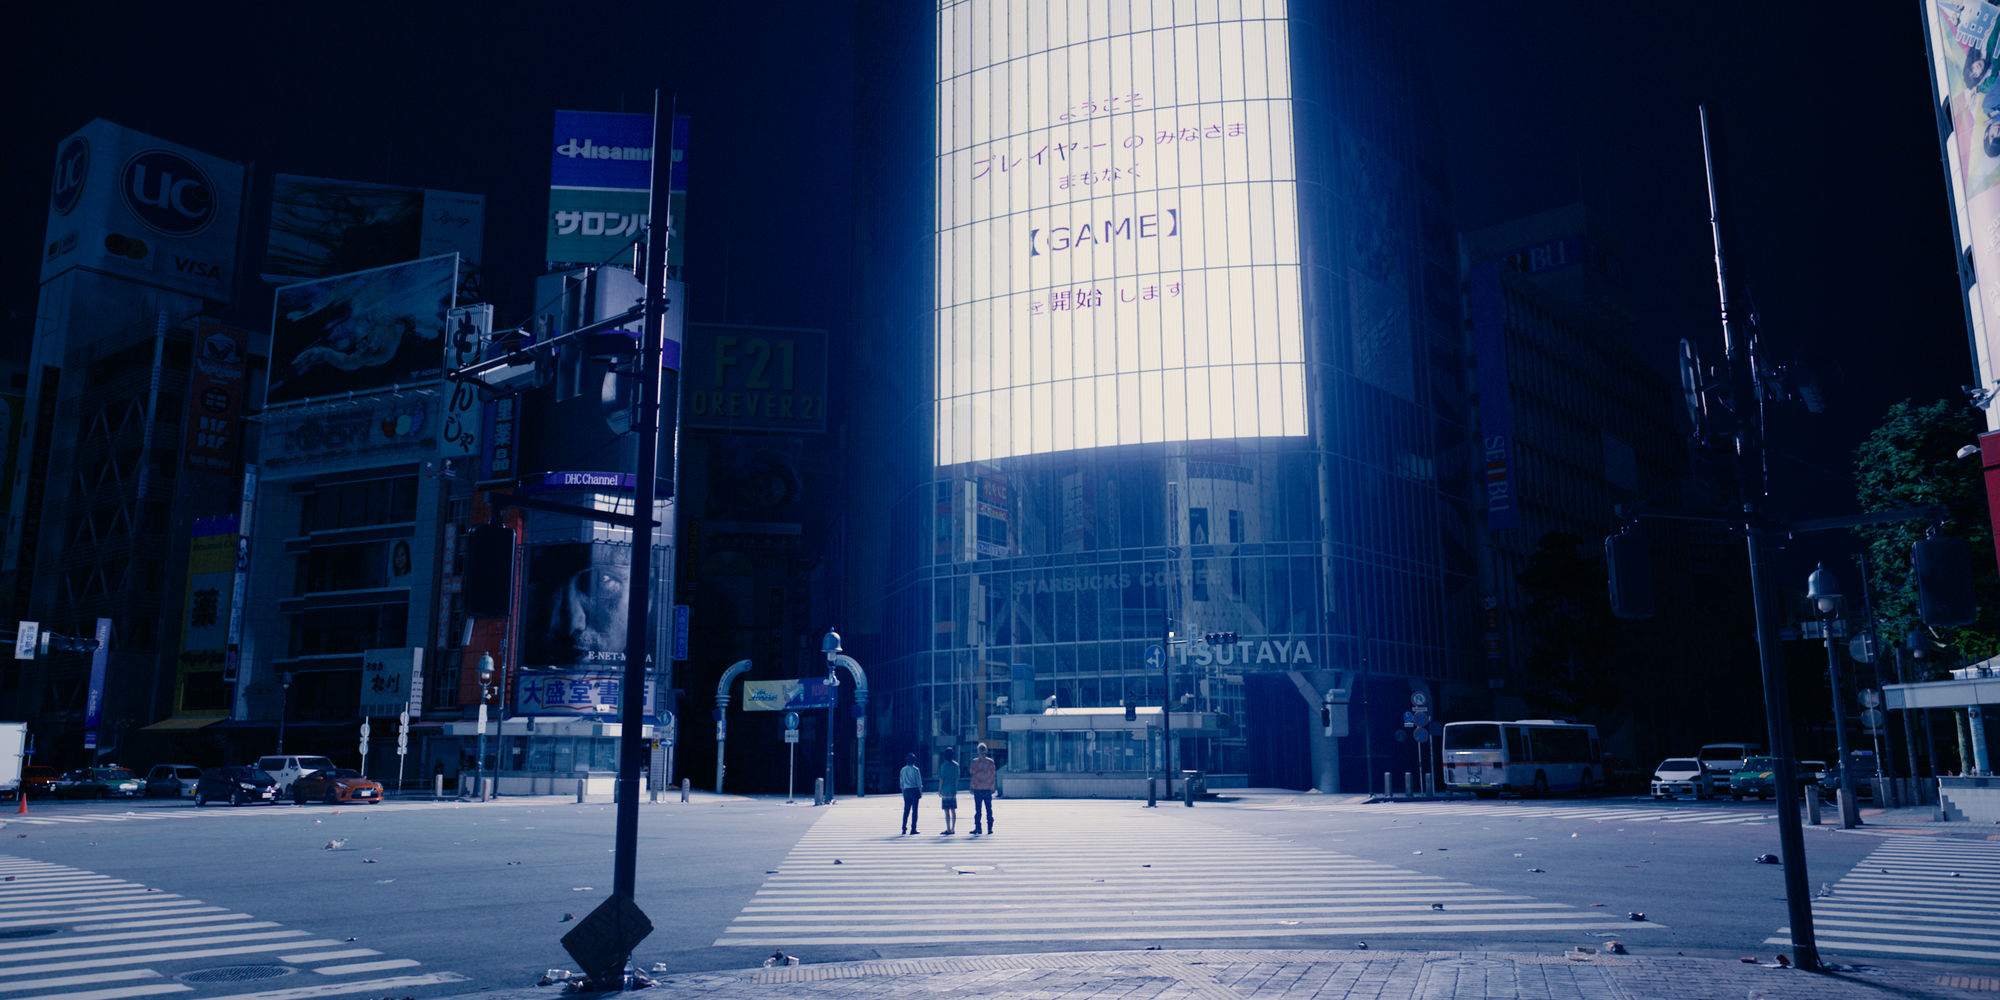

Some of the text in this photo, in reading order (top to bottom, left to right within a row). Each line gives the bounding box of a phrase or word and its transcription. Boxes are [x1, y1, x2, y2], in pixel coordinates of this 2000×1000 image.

[1058, 93, 1144, 121] ようこそ
[556, 138, 684, 163] Hisamiu
[972, 122, 1246, 181] プレイヤー の みなさま
[1058, 162, 1142, 190] まもなく
[172, 254, 222, 282] VISA
[714, 335, 795, 392] F21
[800, 395, 824, 421] 21
[564, 473, 618, 487] DHC Channel
[1484, 434, 1511, 514] SEIBU
[1012, 572, 1132, 597] STARBUCKS
[1175, 640, 1314, 667] TSUTAYA
